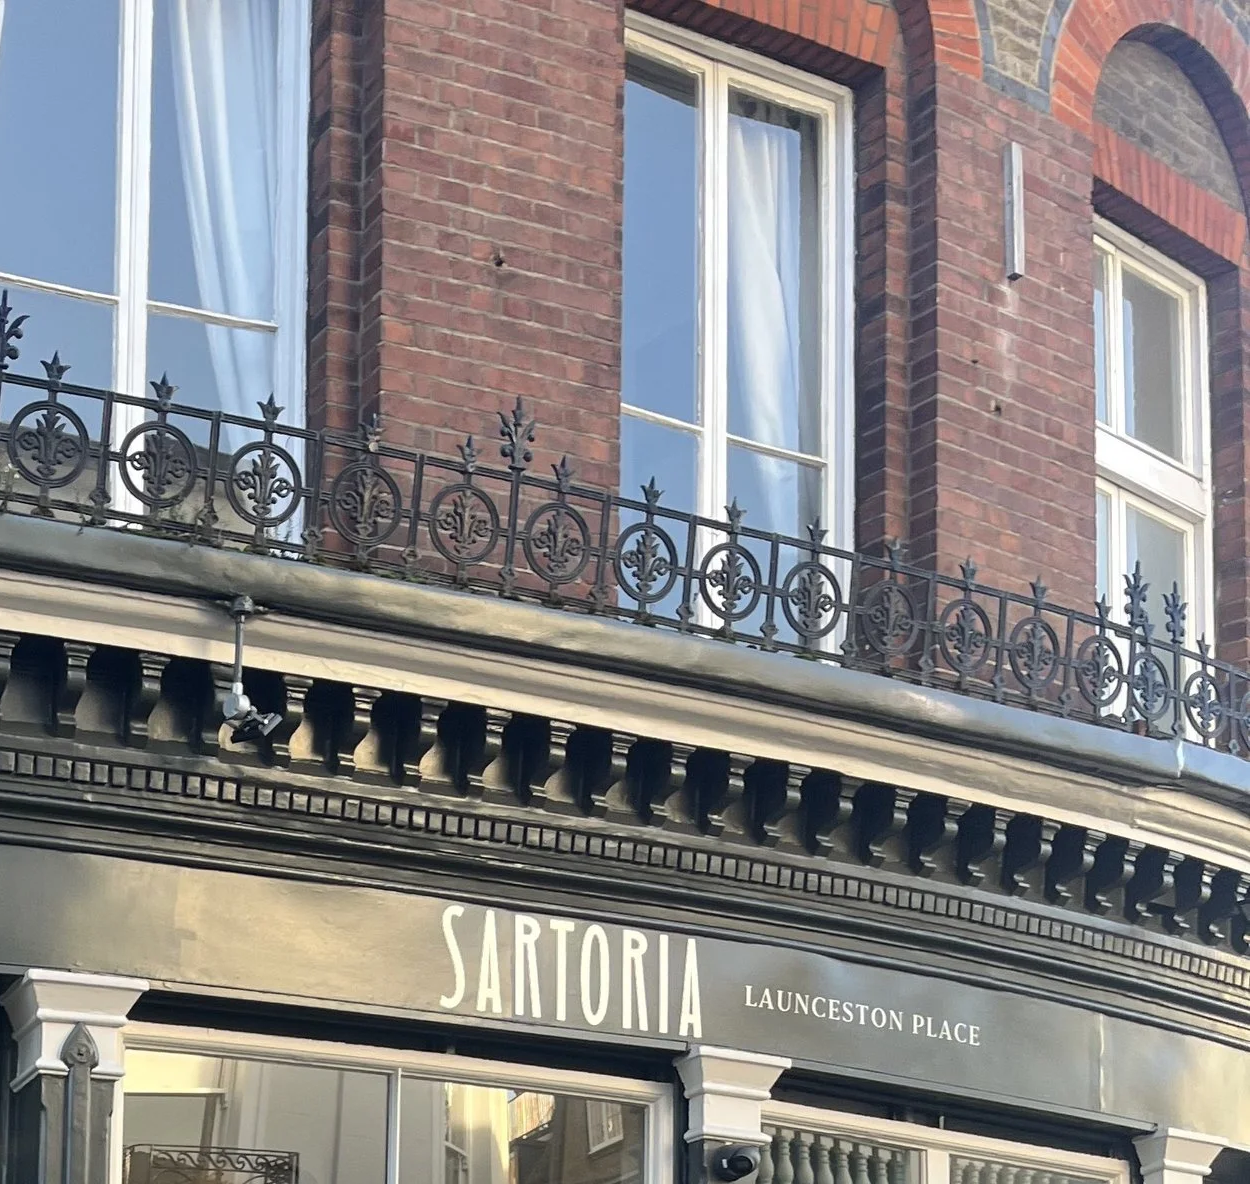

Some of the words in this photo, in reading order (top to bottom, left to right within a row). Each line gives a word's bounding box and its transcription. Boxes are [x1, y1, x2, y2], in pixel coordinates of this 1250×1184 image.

[439, 904, 703, 1038] SARTORIA
[744, 985, 904, 1032] LAUNCESTON
[912, 1014, 981, 1046] PLACE
